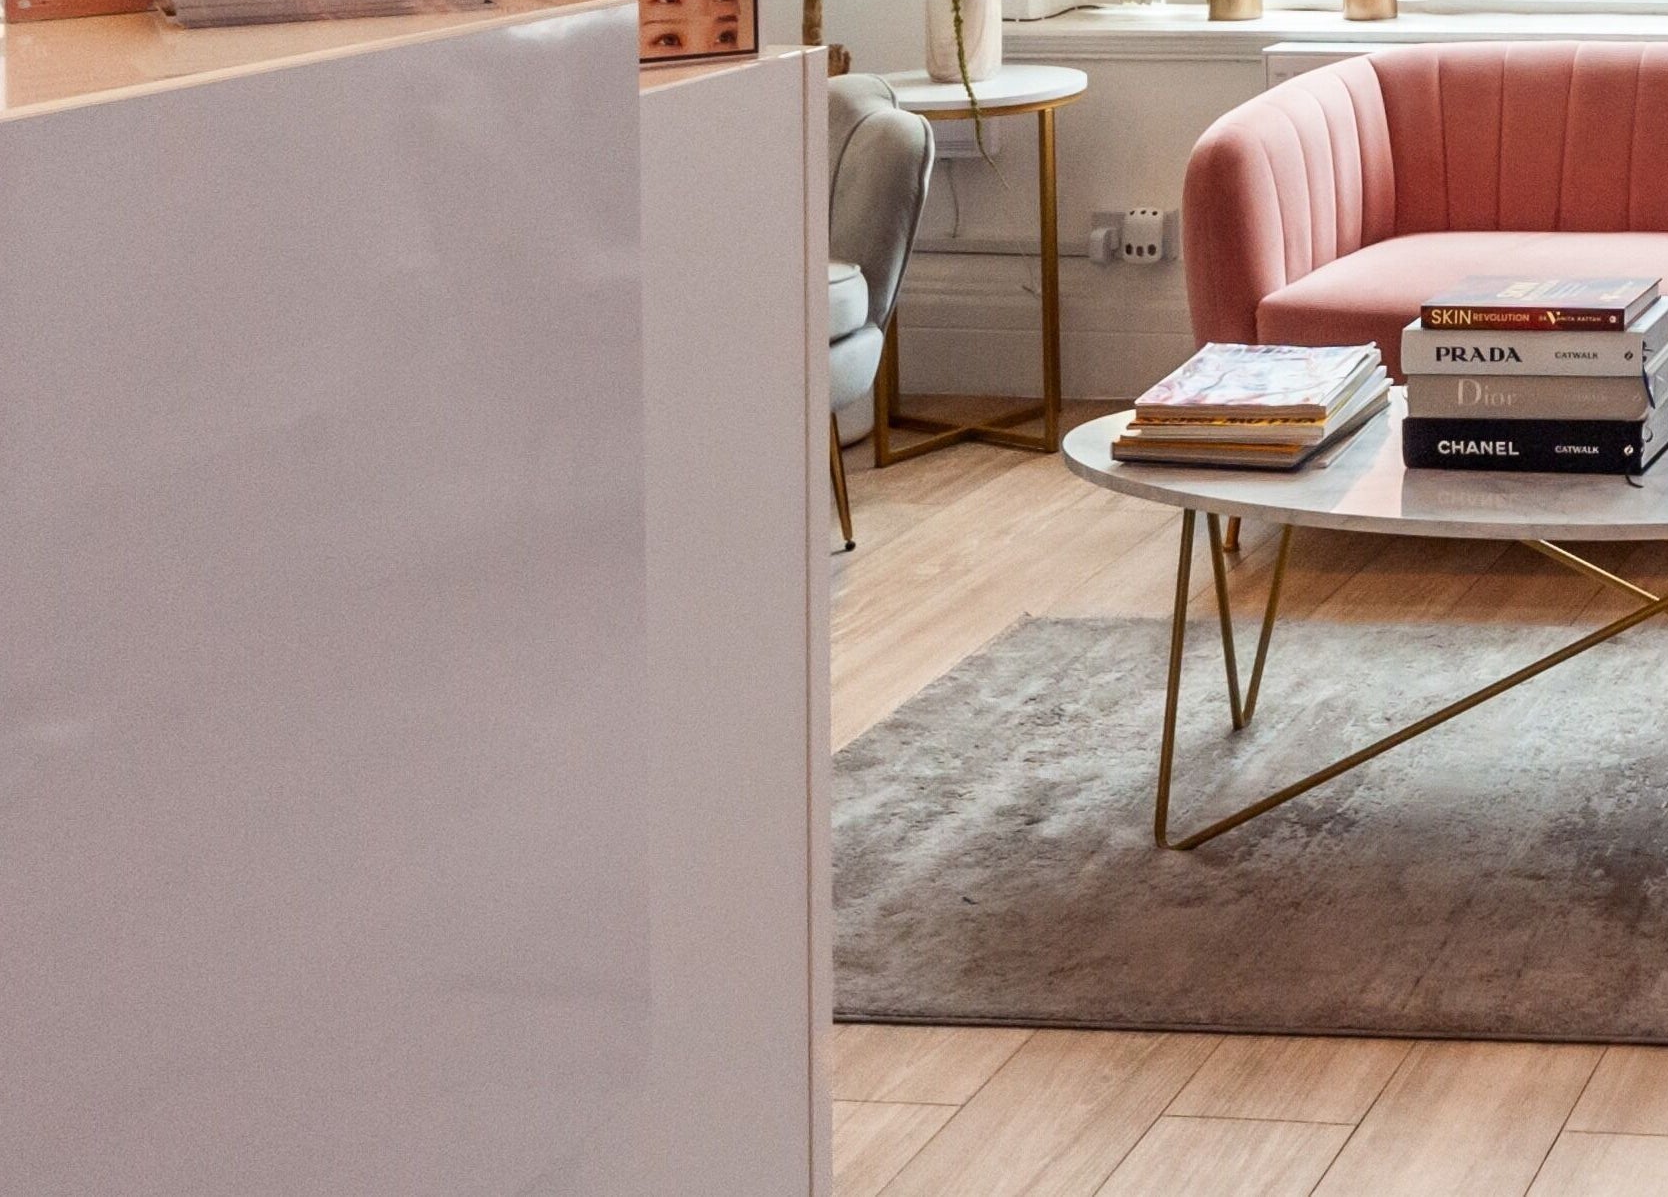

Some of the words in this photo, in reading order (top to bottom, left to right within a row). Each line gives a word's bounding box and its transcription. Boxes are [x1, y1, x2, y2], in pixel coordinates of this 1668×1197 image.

[1430, 309, 1472, 325] SKIN
[1472, 313, 1530, 323] REVOLUTION
[1435, 346, 1523, 363] PRADA
[1554, 351, 1599, 361] CATWALK
[1456, 378, 1518, 407] Dior
[1437, 440, 1520, 456] CHANEL
[1554, 445, 1600, 455] CATWALK
